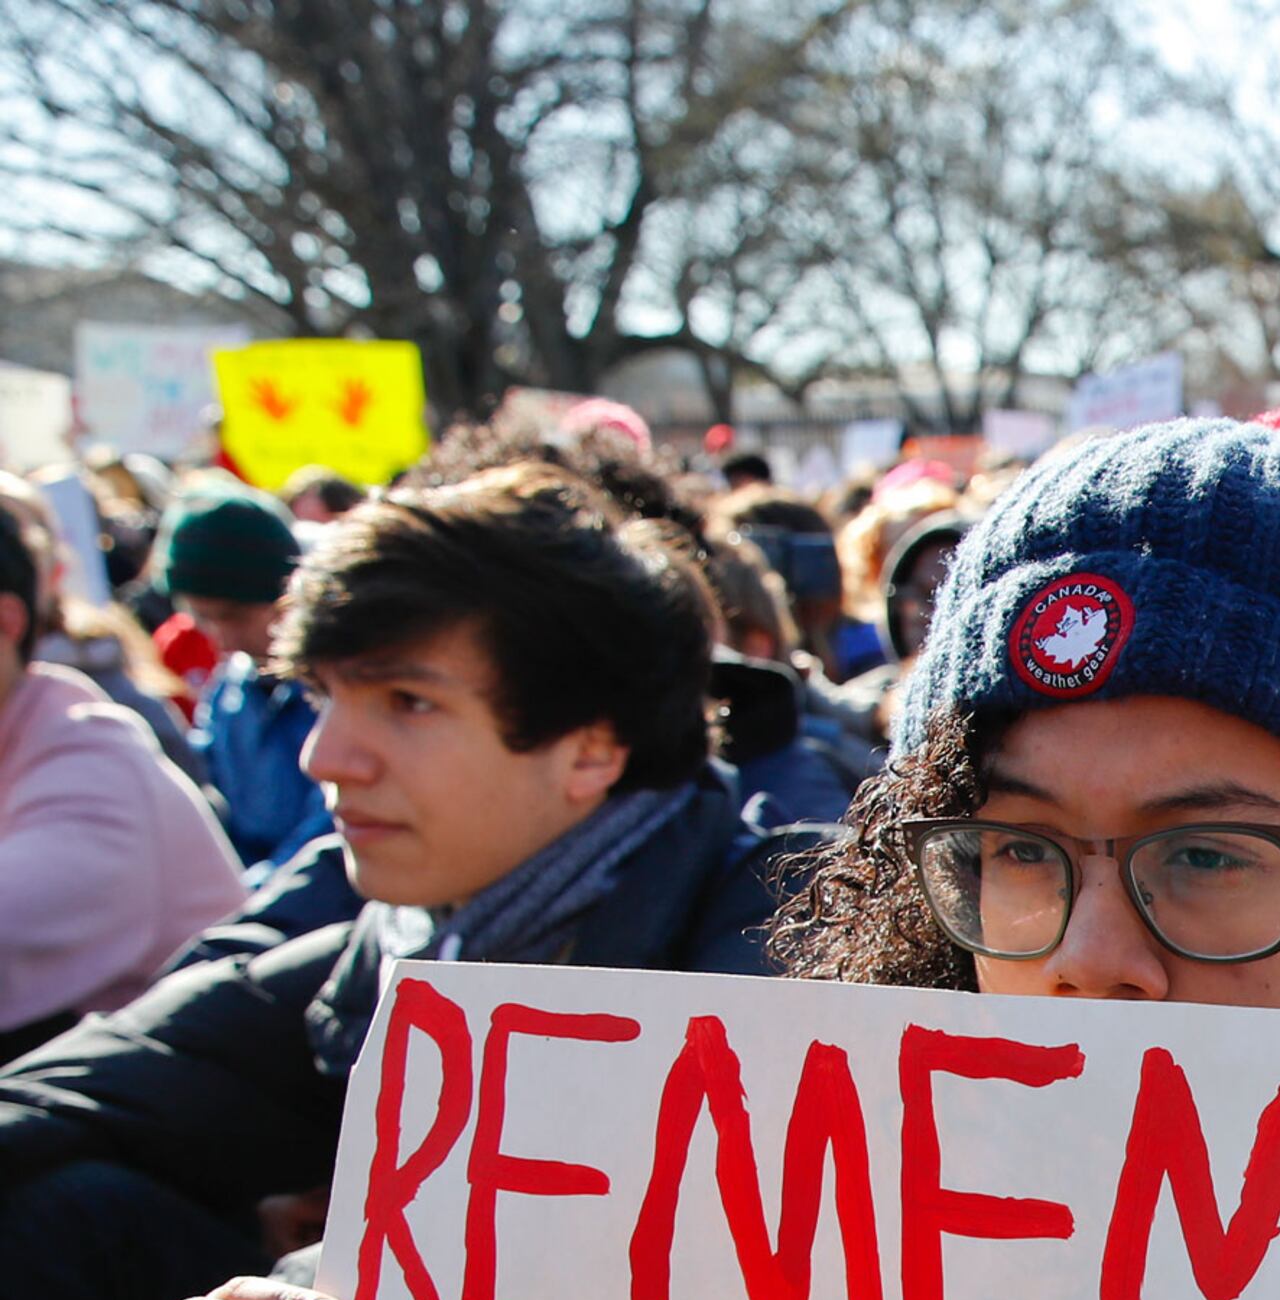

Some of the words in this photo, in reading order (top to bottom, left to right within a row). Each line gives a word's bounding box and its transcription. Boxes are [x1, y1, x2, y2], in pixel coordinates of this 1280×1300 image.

[1035, 584, 1105, 614] CANADA
[1026, 658, 1083, 688] weather
[1083, 644, 1109, 681] gear
